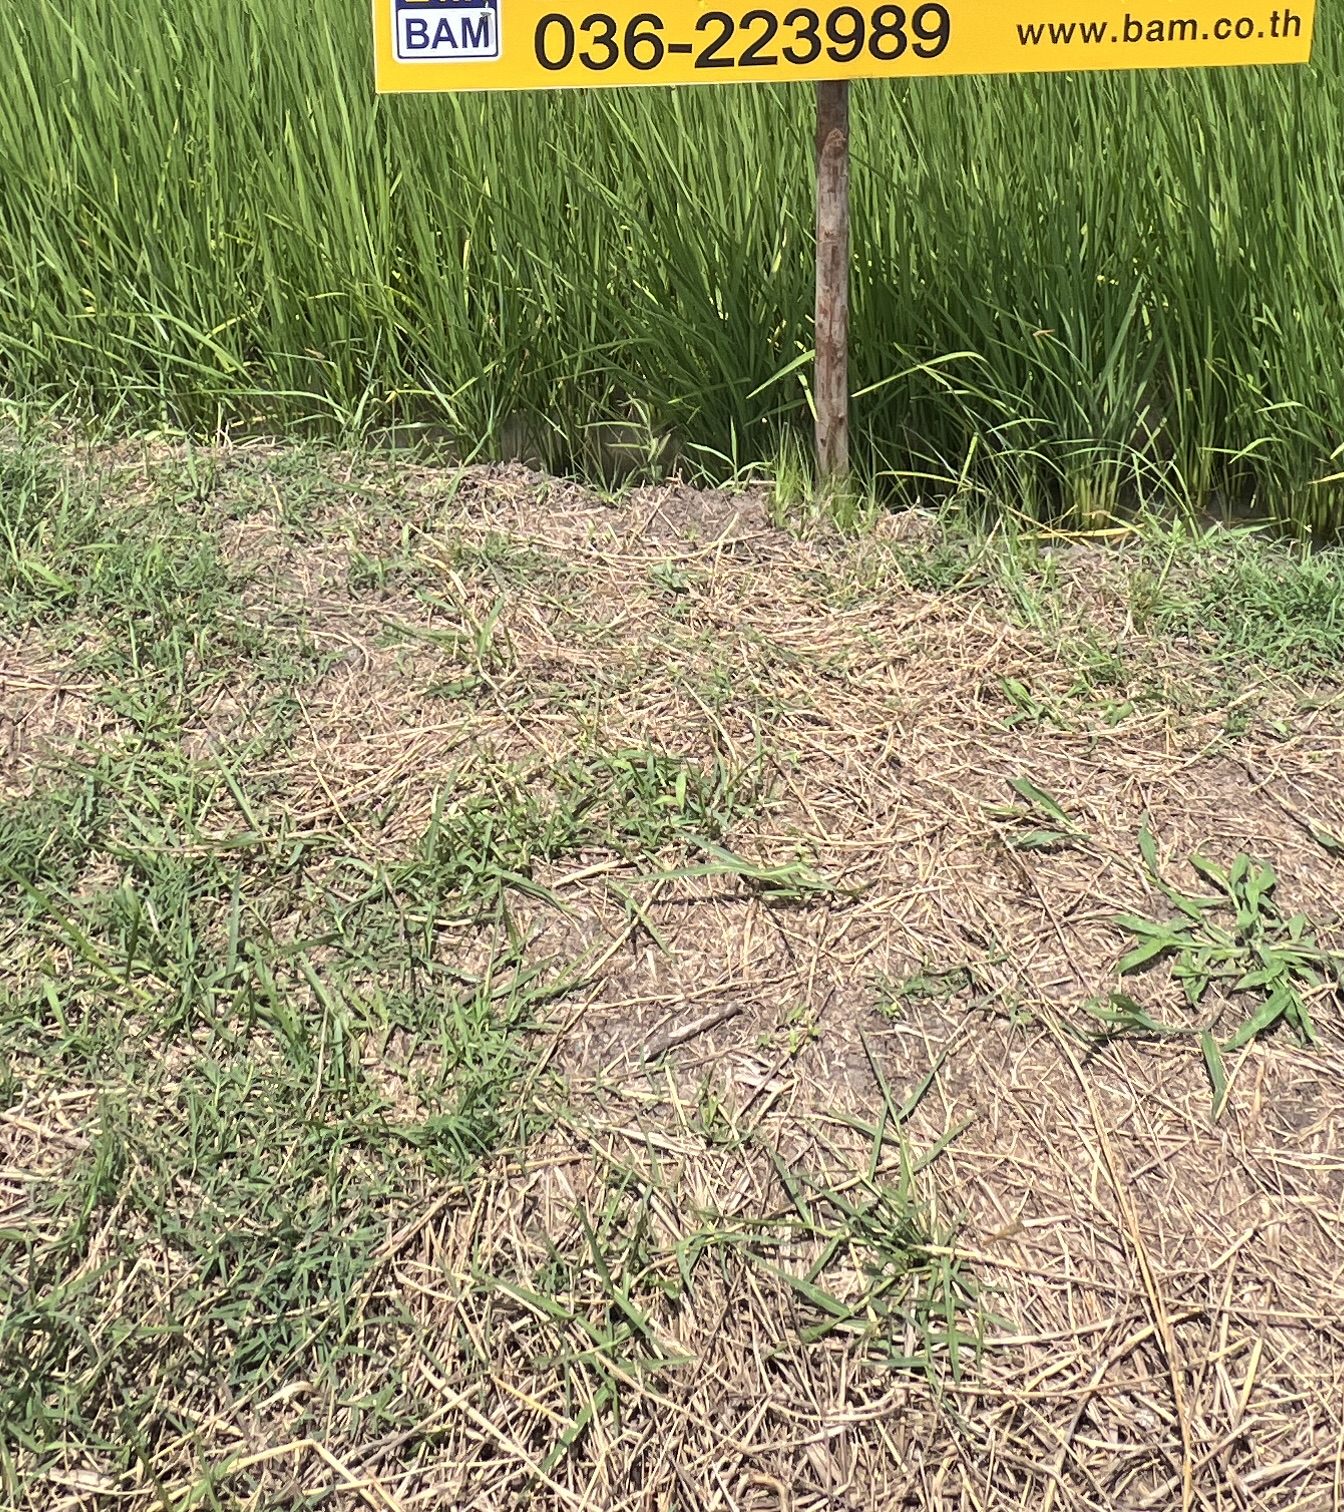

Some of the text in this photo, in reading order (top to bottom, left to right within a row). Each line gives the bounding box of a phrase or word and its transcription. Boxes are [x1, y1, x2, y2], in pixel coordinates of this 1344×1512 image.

[406, 18, 490, 49] BAM
[534, 3, 1301, 70] 036-223989 www.bam.co.th
